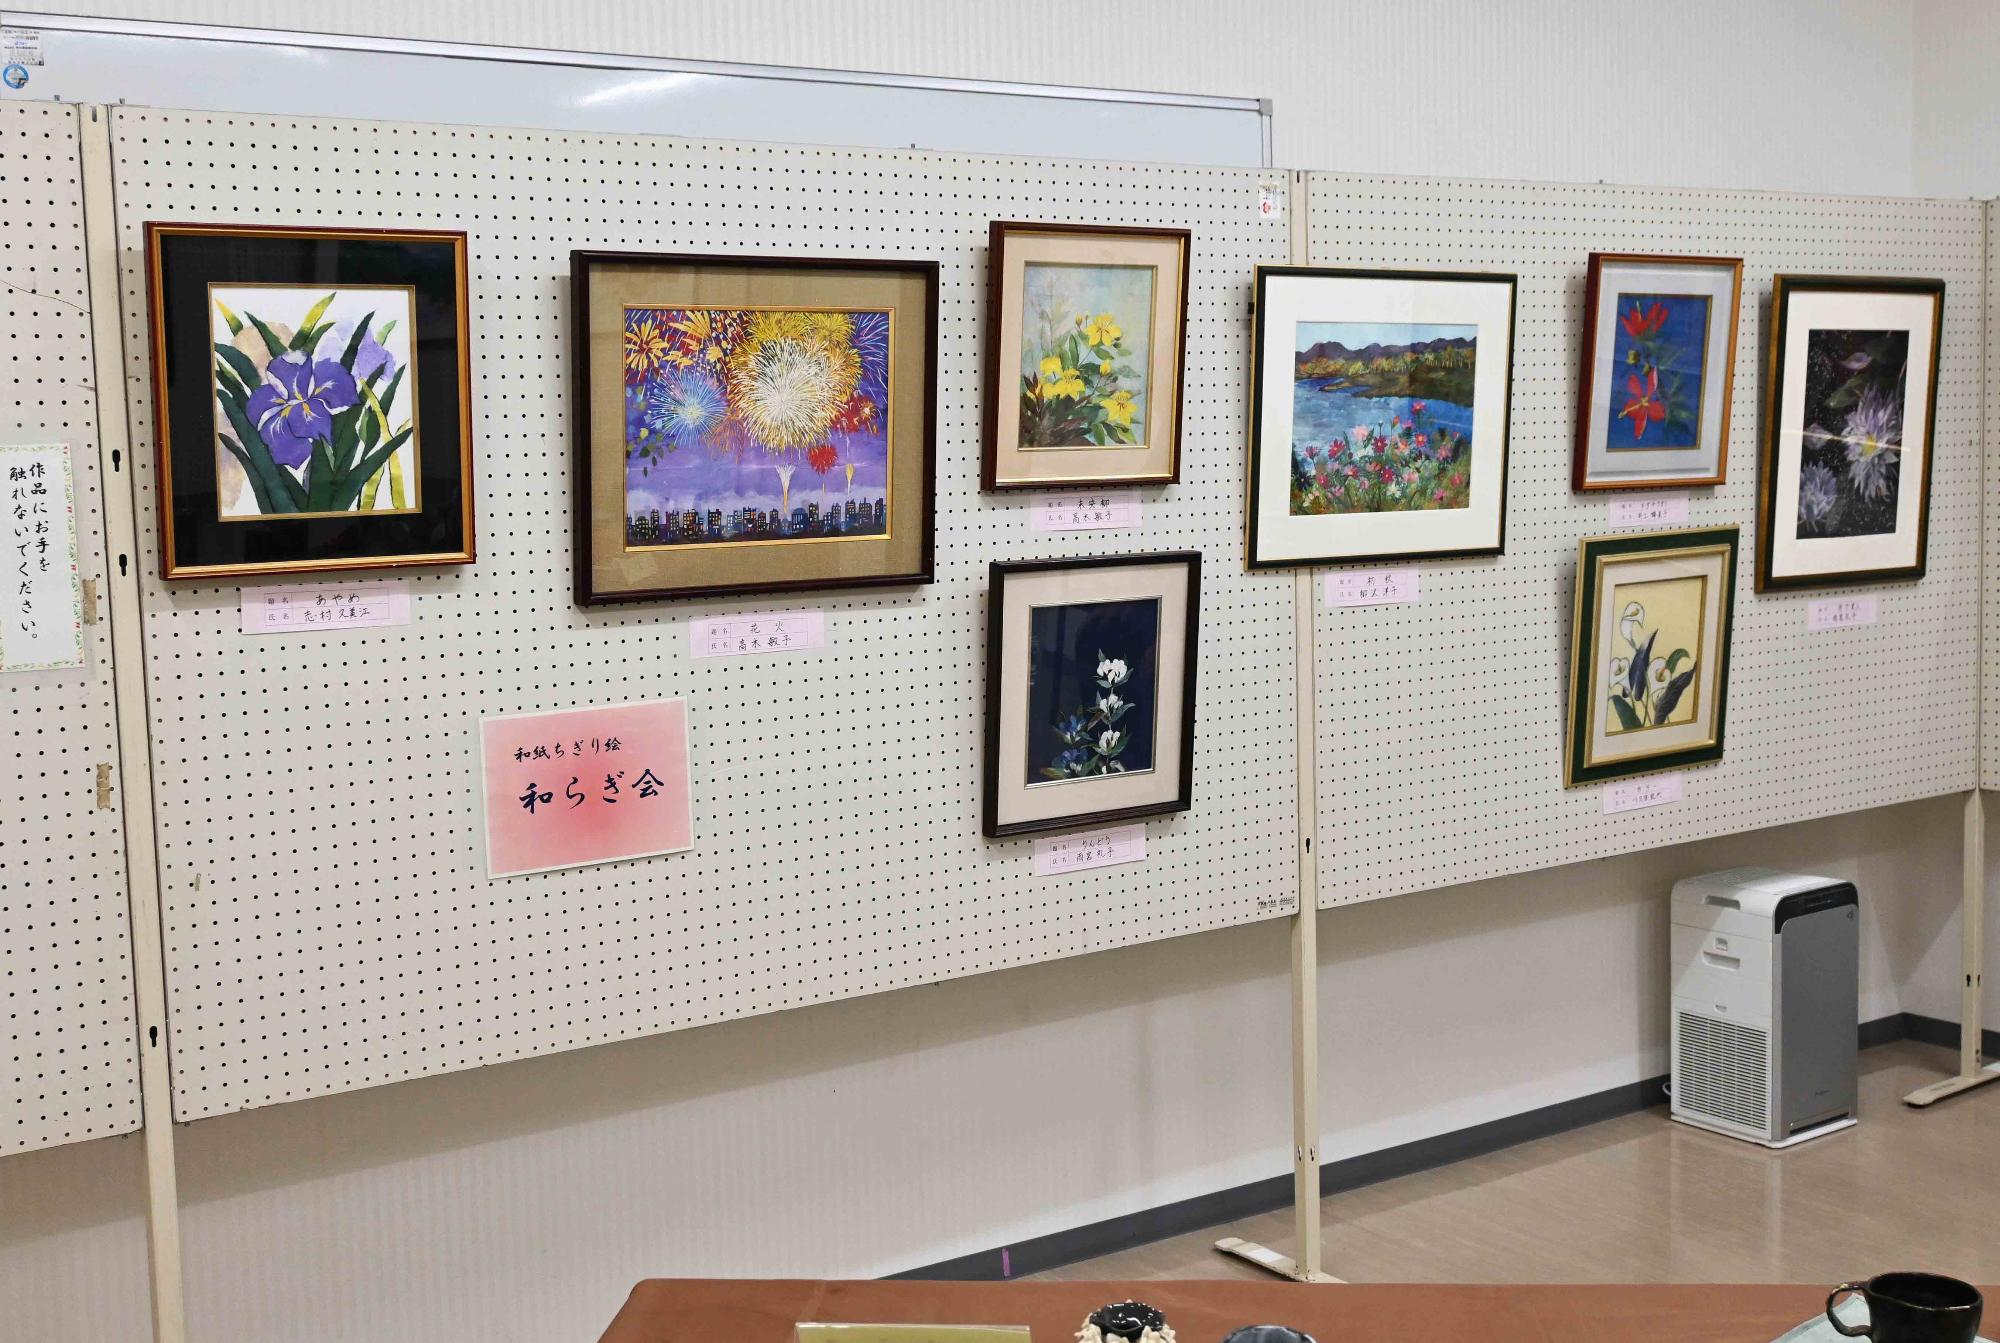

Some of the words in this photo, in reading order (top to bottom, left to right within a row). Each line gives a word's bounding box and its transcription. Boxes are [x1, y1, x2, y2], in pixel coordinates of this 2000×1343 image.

[29, 462, 50, 572] 作品にお手を
[9, 467, 38, 639] 触れないでください。
[315, 593, 360, 606] あやめ
[750, 621, 784, 634] 花火
[513, 736, 622, 763] 和紙ちぎり絵
[519, 768, 665, 815] 和らぎ会
[1082, 835, 1111, 849] りんどう
